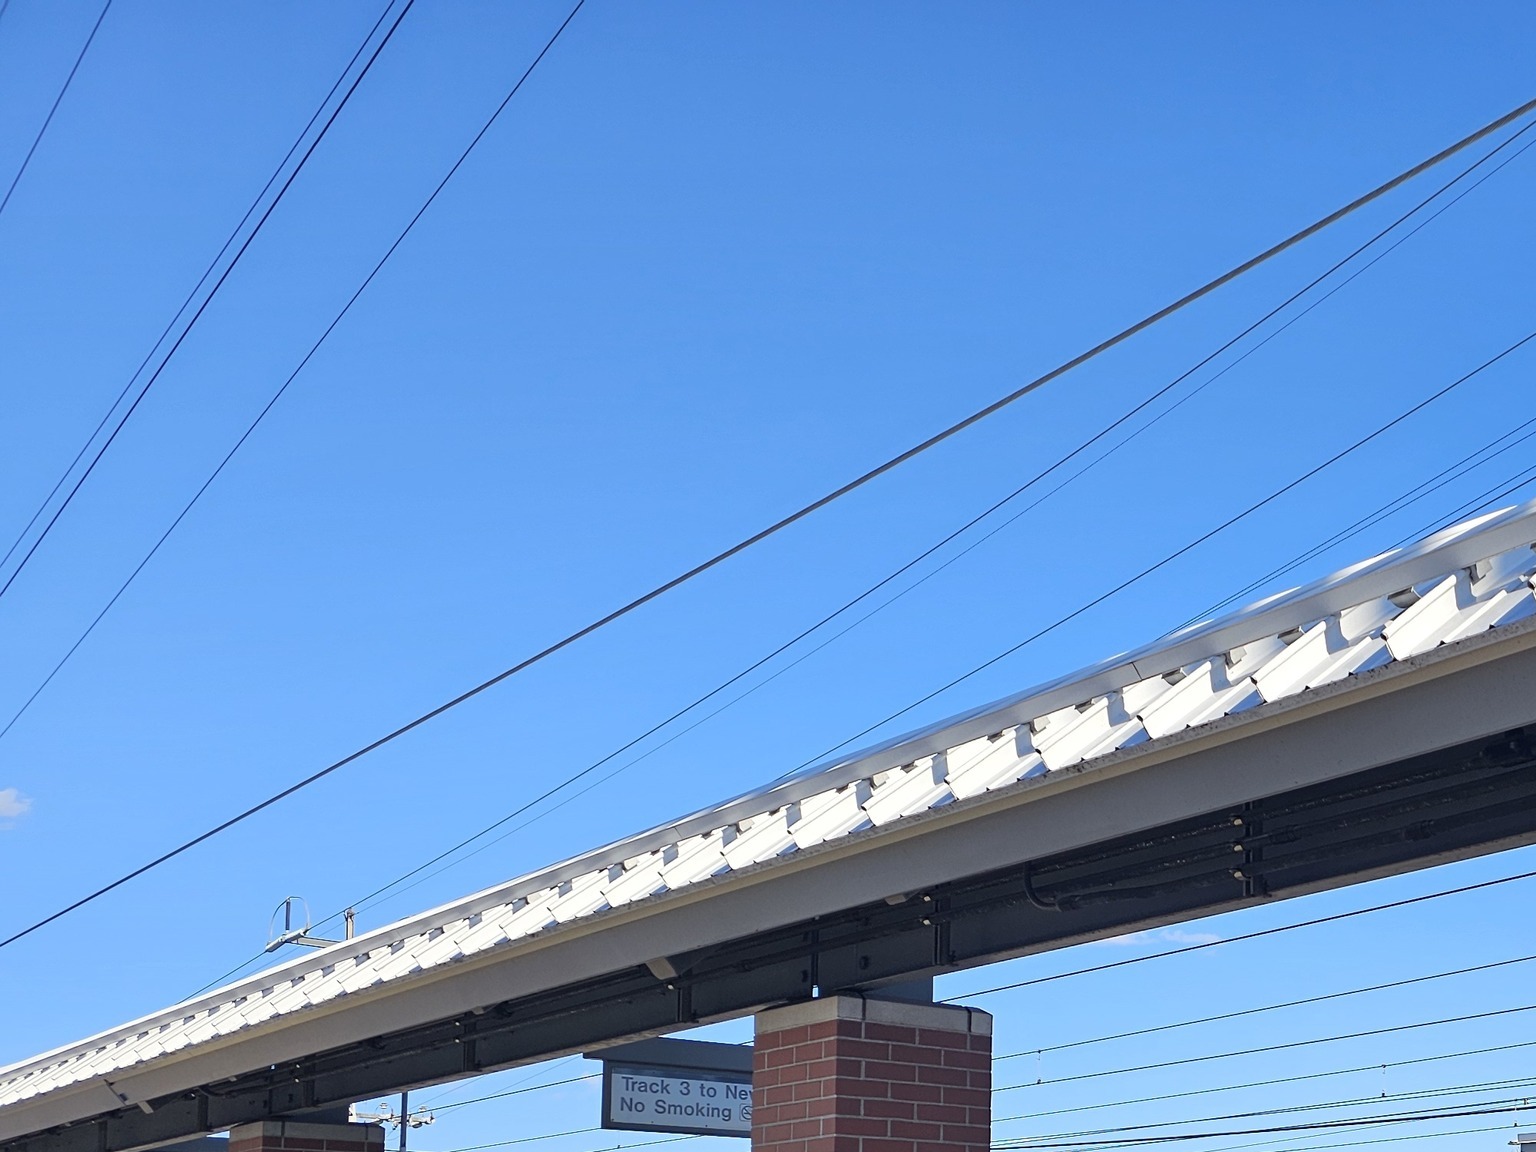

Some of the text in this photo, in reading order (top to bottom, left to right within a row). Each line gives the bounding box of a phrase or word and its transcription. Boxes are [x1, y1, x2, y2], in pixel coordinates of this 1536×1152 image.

[621, 1076, 671, 1095] Track
[679, 1081, 690, 1096] 3
[700, 1083, 717, 1098] to
[620, 1097, 732, 1122] No Smoking
